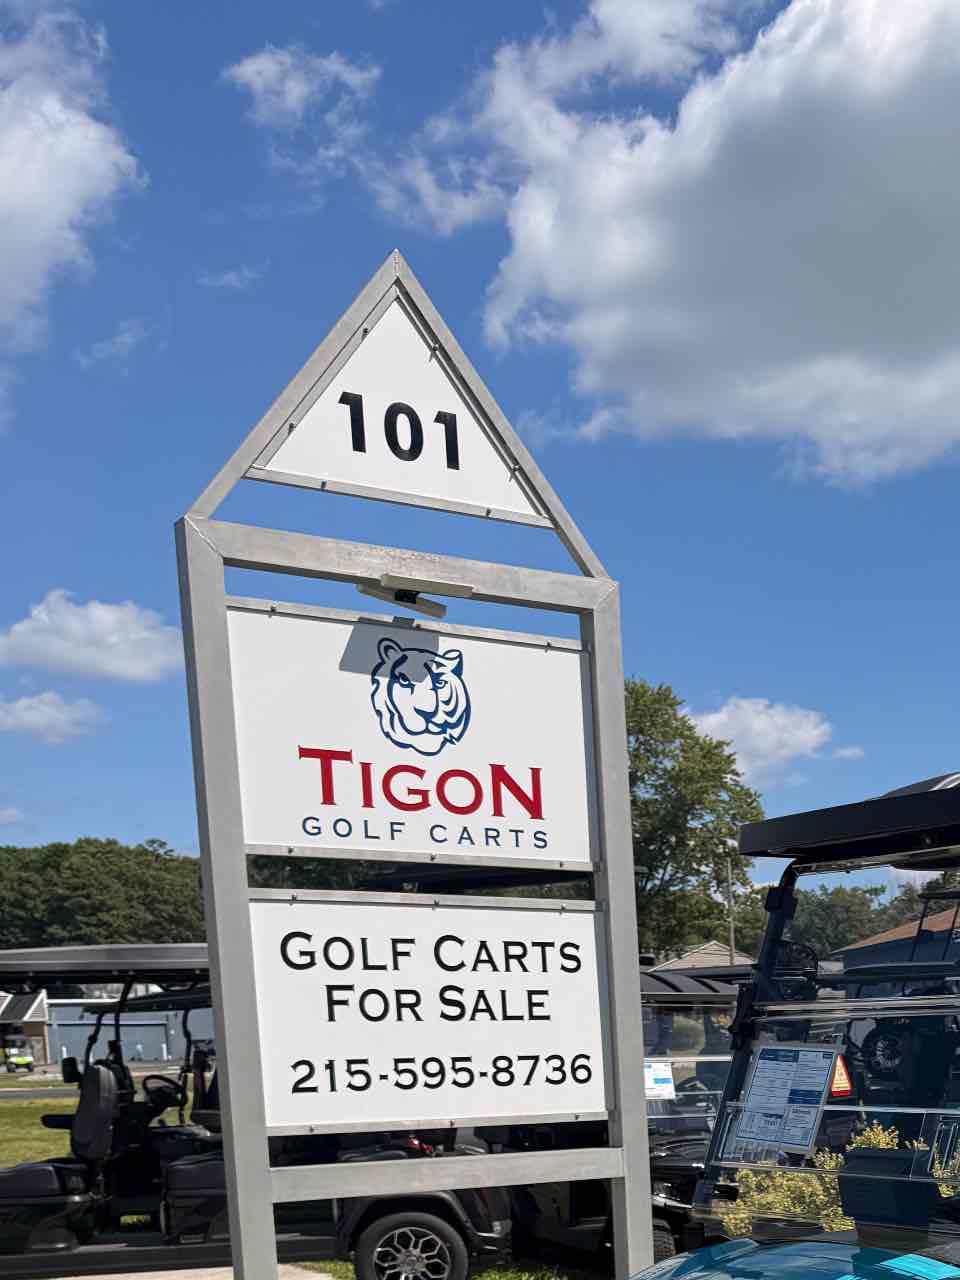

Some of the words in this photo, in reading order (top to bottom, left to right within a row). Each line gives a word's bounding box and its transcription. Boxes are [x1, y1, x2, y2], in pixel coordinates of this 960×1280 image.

[338, 391, 460, 471] 101
[297, 746, 544, 820] TIGON
[301, 816, 406, 841] GOLF
[429, 824, 549, 849] CARTS
[279, 931, 416, 971] GOLF
[433, 934, 582, 974] CARTS
[324, 983, 425, 1023] FOR
[438, 984, 551, 1022] SALE
[290, 1053, 593, 1095] 215-595-8736
